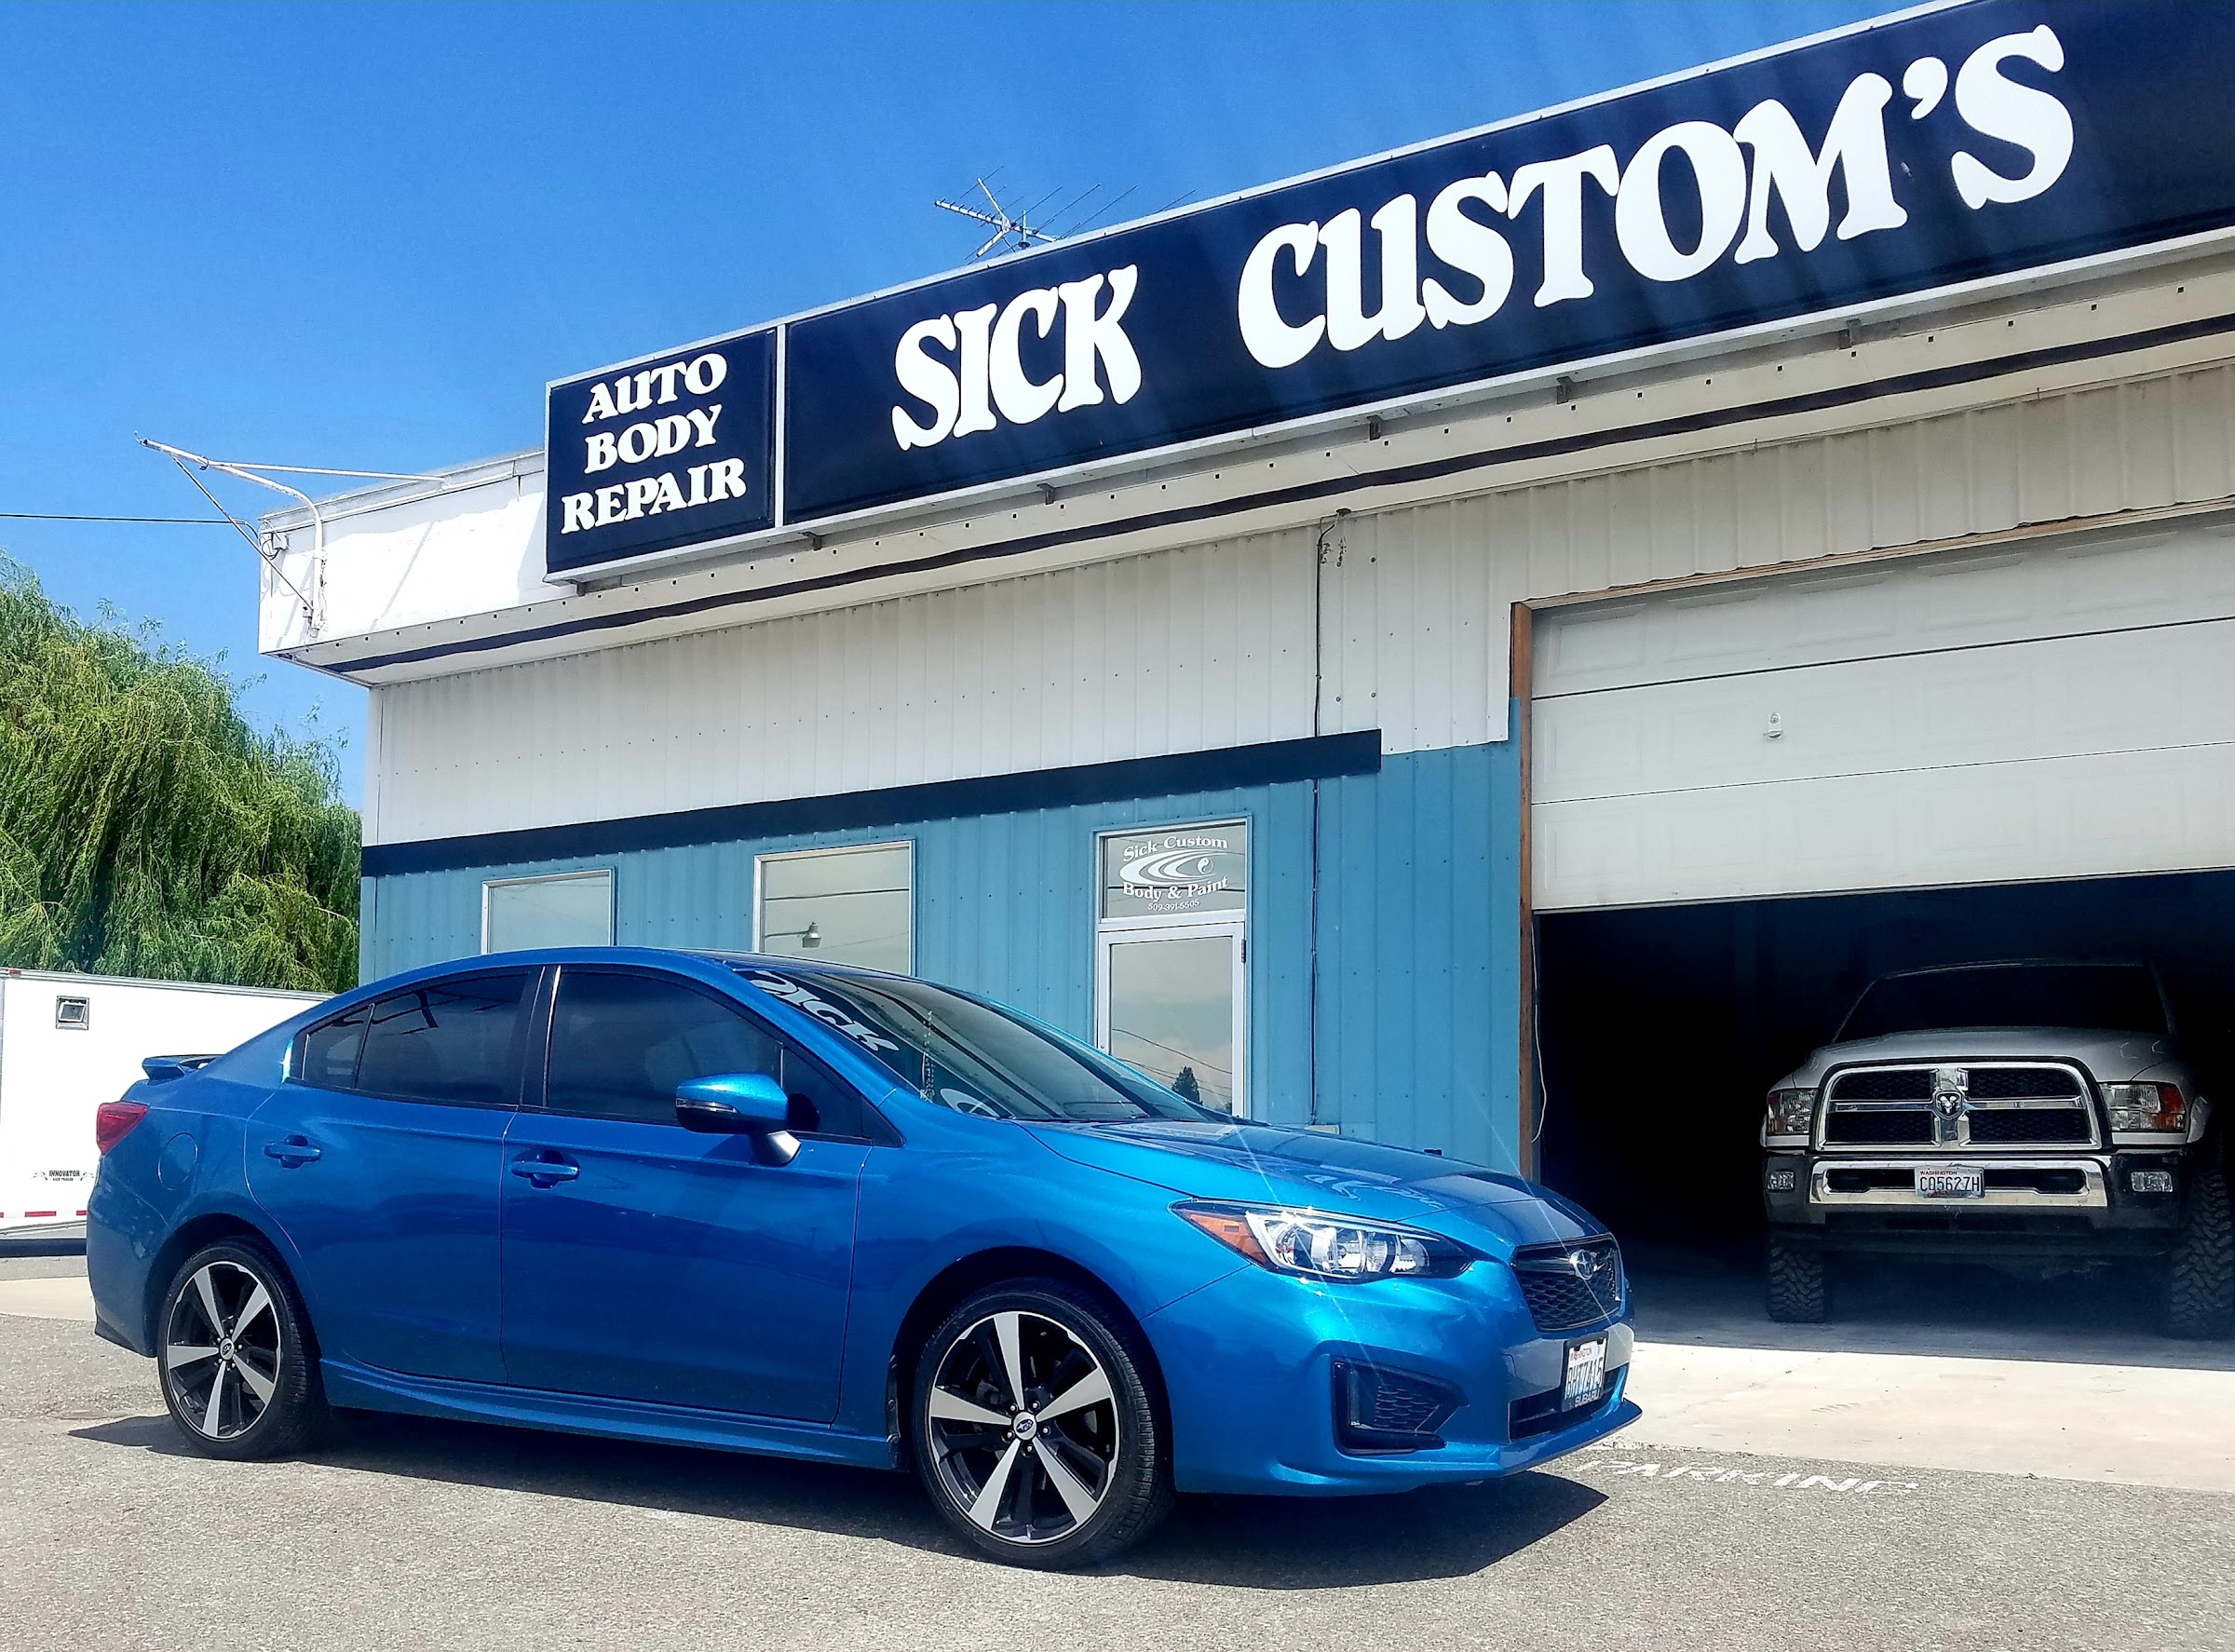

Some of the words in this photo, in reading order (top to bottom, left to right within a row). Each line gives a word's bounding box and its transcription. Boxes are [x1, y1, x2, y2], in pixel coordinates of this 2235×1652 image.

[892, 264, 1142, 451] SICK
[1239, 25, 2074, 370] CUSTOM'S
[582, 353, 727, 425] AUTO
[584, 404, 723, 475] BODY
[561, 457, 747, 535] REPAIR
[1123, 841, 1158, 862] Sick
[1164, 835, 1228, 849] Custom
[1122, 881, 1163, 902] Body
[1167, 886, 1183, 900] &
[1187, 875, 1229, 899] Paint
[1147, 899, 1200, 911] 509-391-5505
[1574, 1388, 1601, 1408] SUBARU
